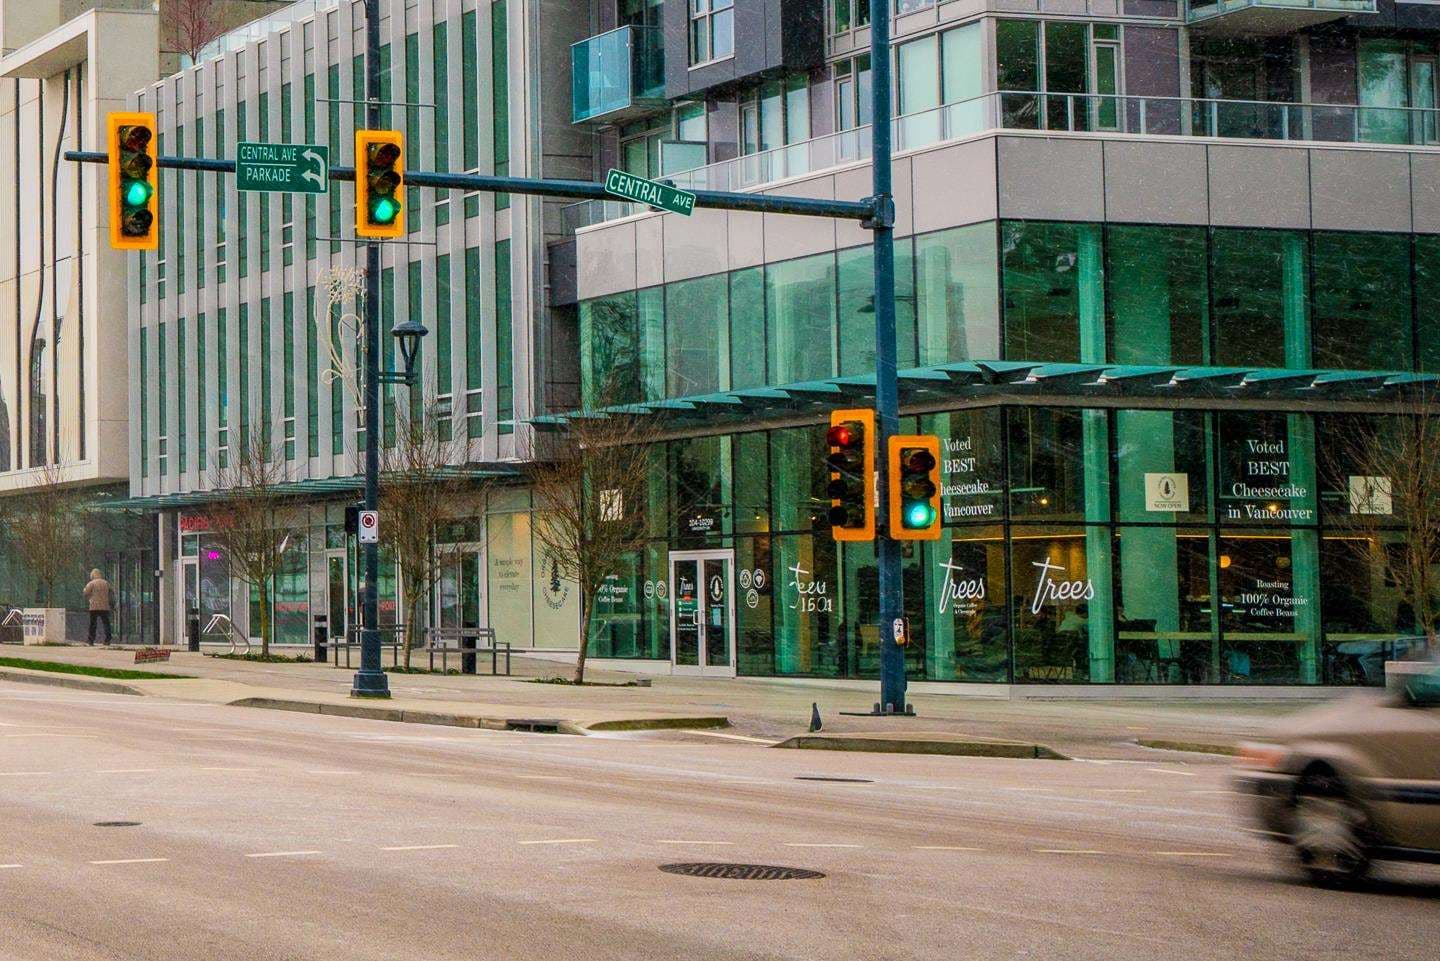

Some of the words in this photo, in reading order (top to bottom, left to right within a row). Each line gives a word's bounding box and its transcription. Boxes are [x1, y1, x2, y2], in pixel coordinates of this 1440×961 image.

[241, 146, 279, 161] CENTRAL
[281, 148, 297, 161] AVE
[246, 167, 291, 182] PARKADE
[609, 173, 663, 205] CENTRAL
[672, 193, 692, 209] AVE
[944, 437, 972, 452] Voted
[1247, 439, 1285, 454] Voted
[944, 458, 976, 474] BEST
[1248, 461, 1290, 476] BEST
[940, 479, 989, 497] heesecake
[1232, 482, 1307, 498] Cheesecake
[1228, 505, 1241, 519] in
[1244, 504, 1313, 519] Vancouver
[939, 557, 985, 614] Trees
[1032, 556, 1095, 615] Trees
[1257, 579, 1290, 590] Roasting
[1241, 593, 1269, 606] 100%
[1272, 594, 1308, 608] Organic
[1250, 608, 1274, 617] Coffee
